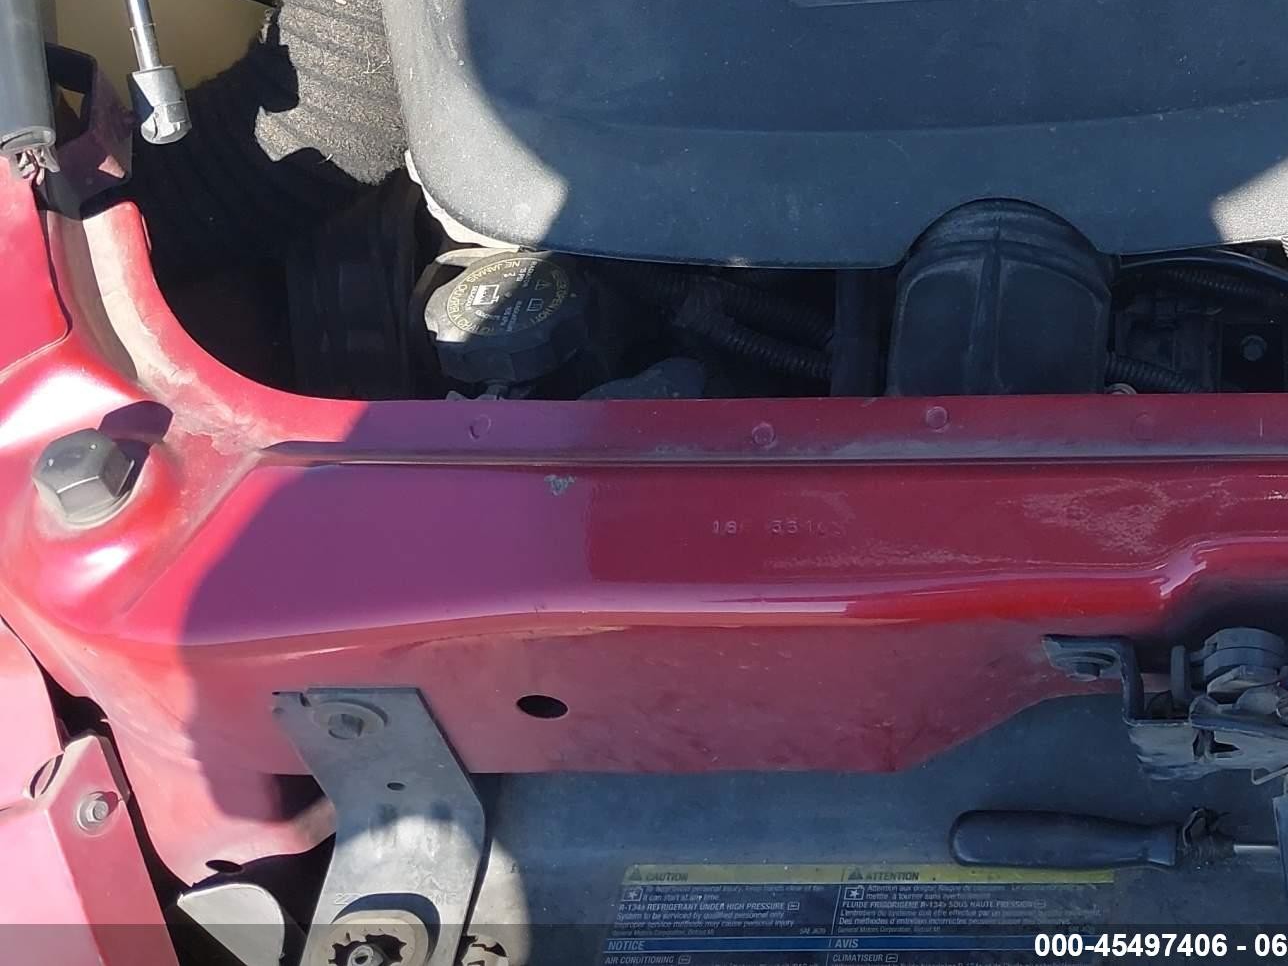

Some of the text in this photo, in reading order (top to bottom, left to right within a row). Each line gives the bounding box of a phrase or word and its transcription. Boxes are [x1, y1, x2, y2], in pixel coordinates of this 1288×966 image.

[645, 872, 689, 882] CAUTION
[866, 871, 920, 882] ATTENTION
[647, 903, 698, 911] REFRIGERANT
[700, 902, 725, 911] UNDER
[726, 902, 745, 910] HIGH
[746, 902, 785, 910] PRESSURE
[607, 940, 646, 951] NOTICE
[834, 938, 859, 948] AVIS
[605, 954, 675, 965] AIR CONDITIONING
[832, 953, 884, 963] CLIMATISEUR
